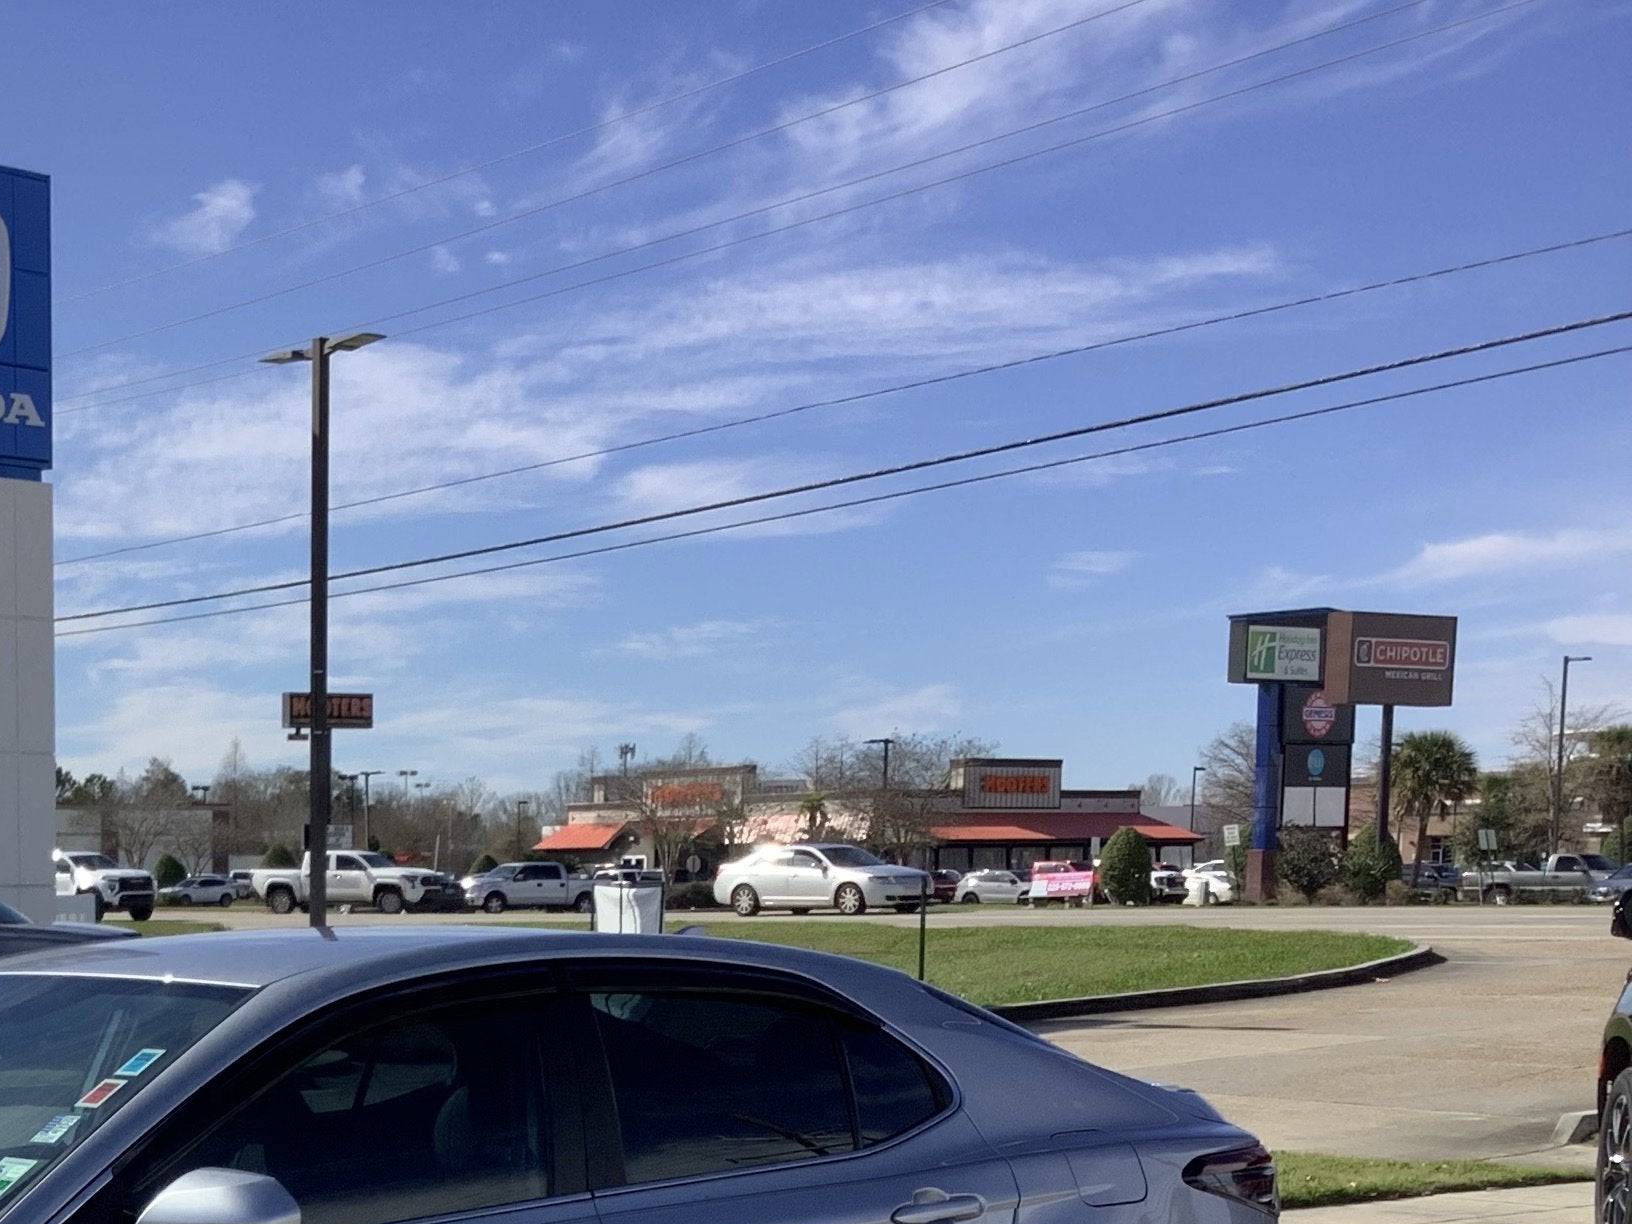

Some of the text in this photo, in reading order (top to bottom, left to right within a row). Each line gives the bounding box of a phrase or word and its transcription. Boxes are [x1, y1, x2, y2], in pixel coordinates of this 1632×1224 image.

[1278, 644, 1316, 663] Express
[1376, 646, 1445, 663] CHIPOTLE
[1385, 671, 1442, 681] MEXICAN GRILL
[291, 697, 372, 717] HTERS
